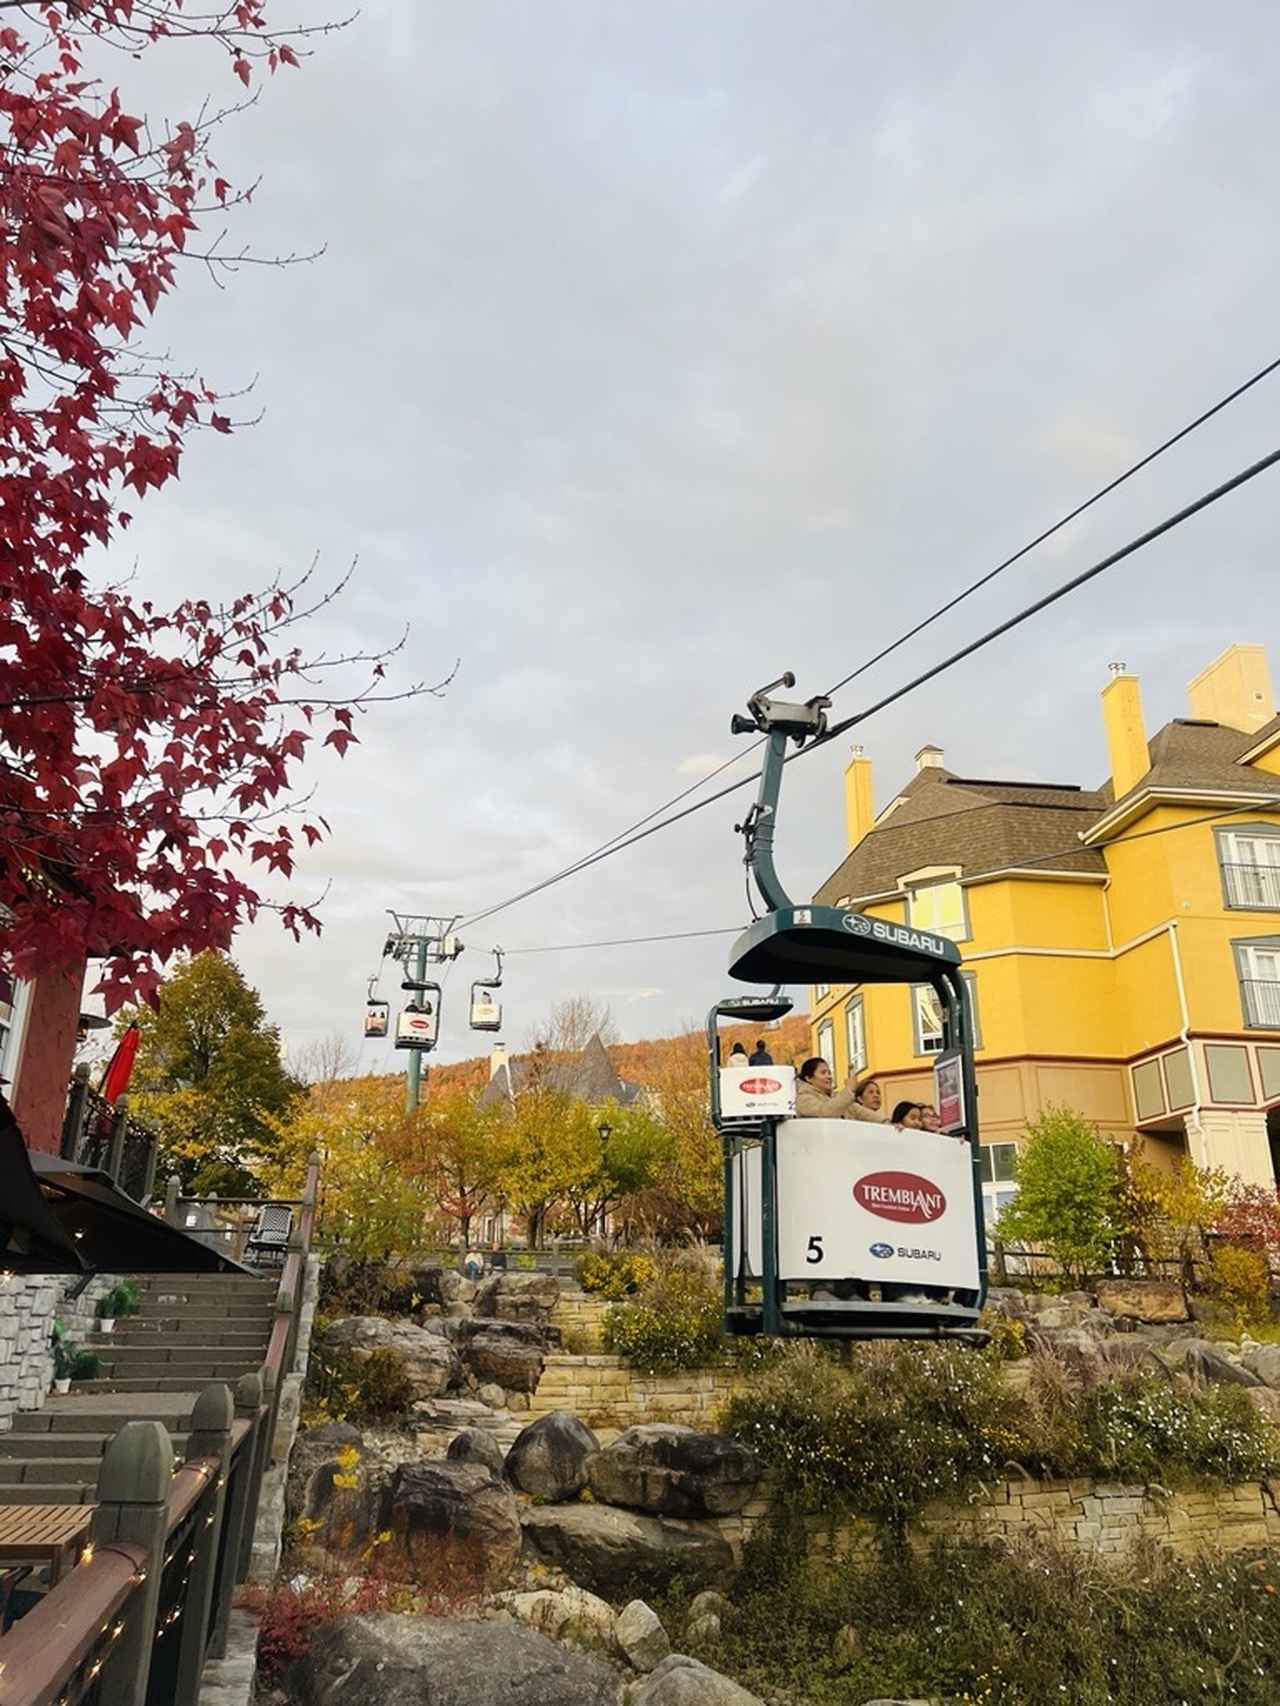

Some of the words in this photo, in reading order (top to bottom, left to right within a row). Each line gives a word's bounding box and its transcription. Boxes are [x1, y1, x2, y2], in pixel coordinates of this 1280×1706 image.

[873, 922, 945, 955] SUBARU
[862, 1184, 942, 1219] TREMBLANT
[806, 1236, 824, 1264] 5
[897, 1247, 942, 1261] SUBARU
